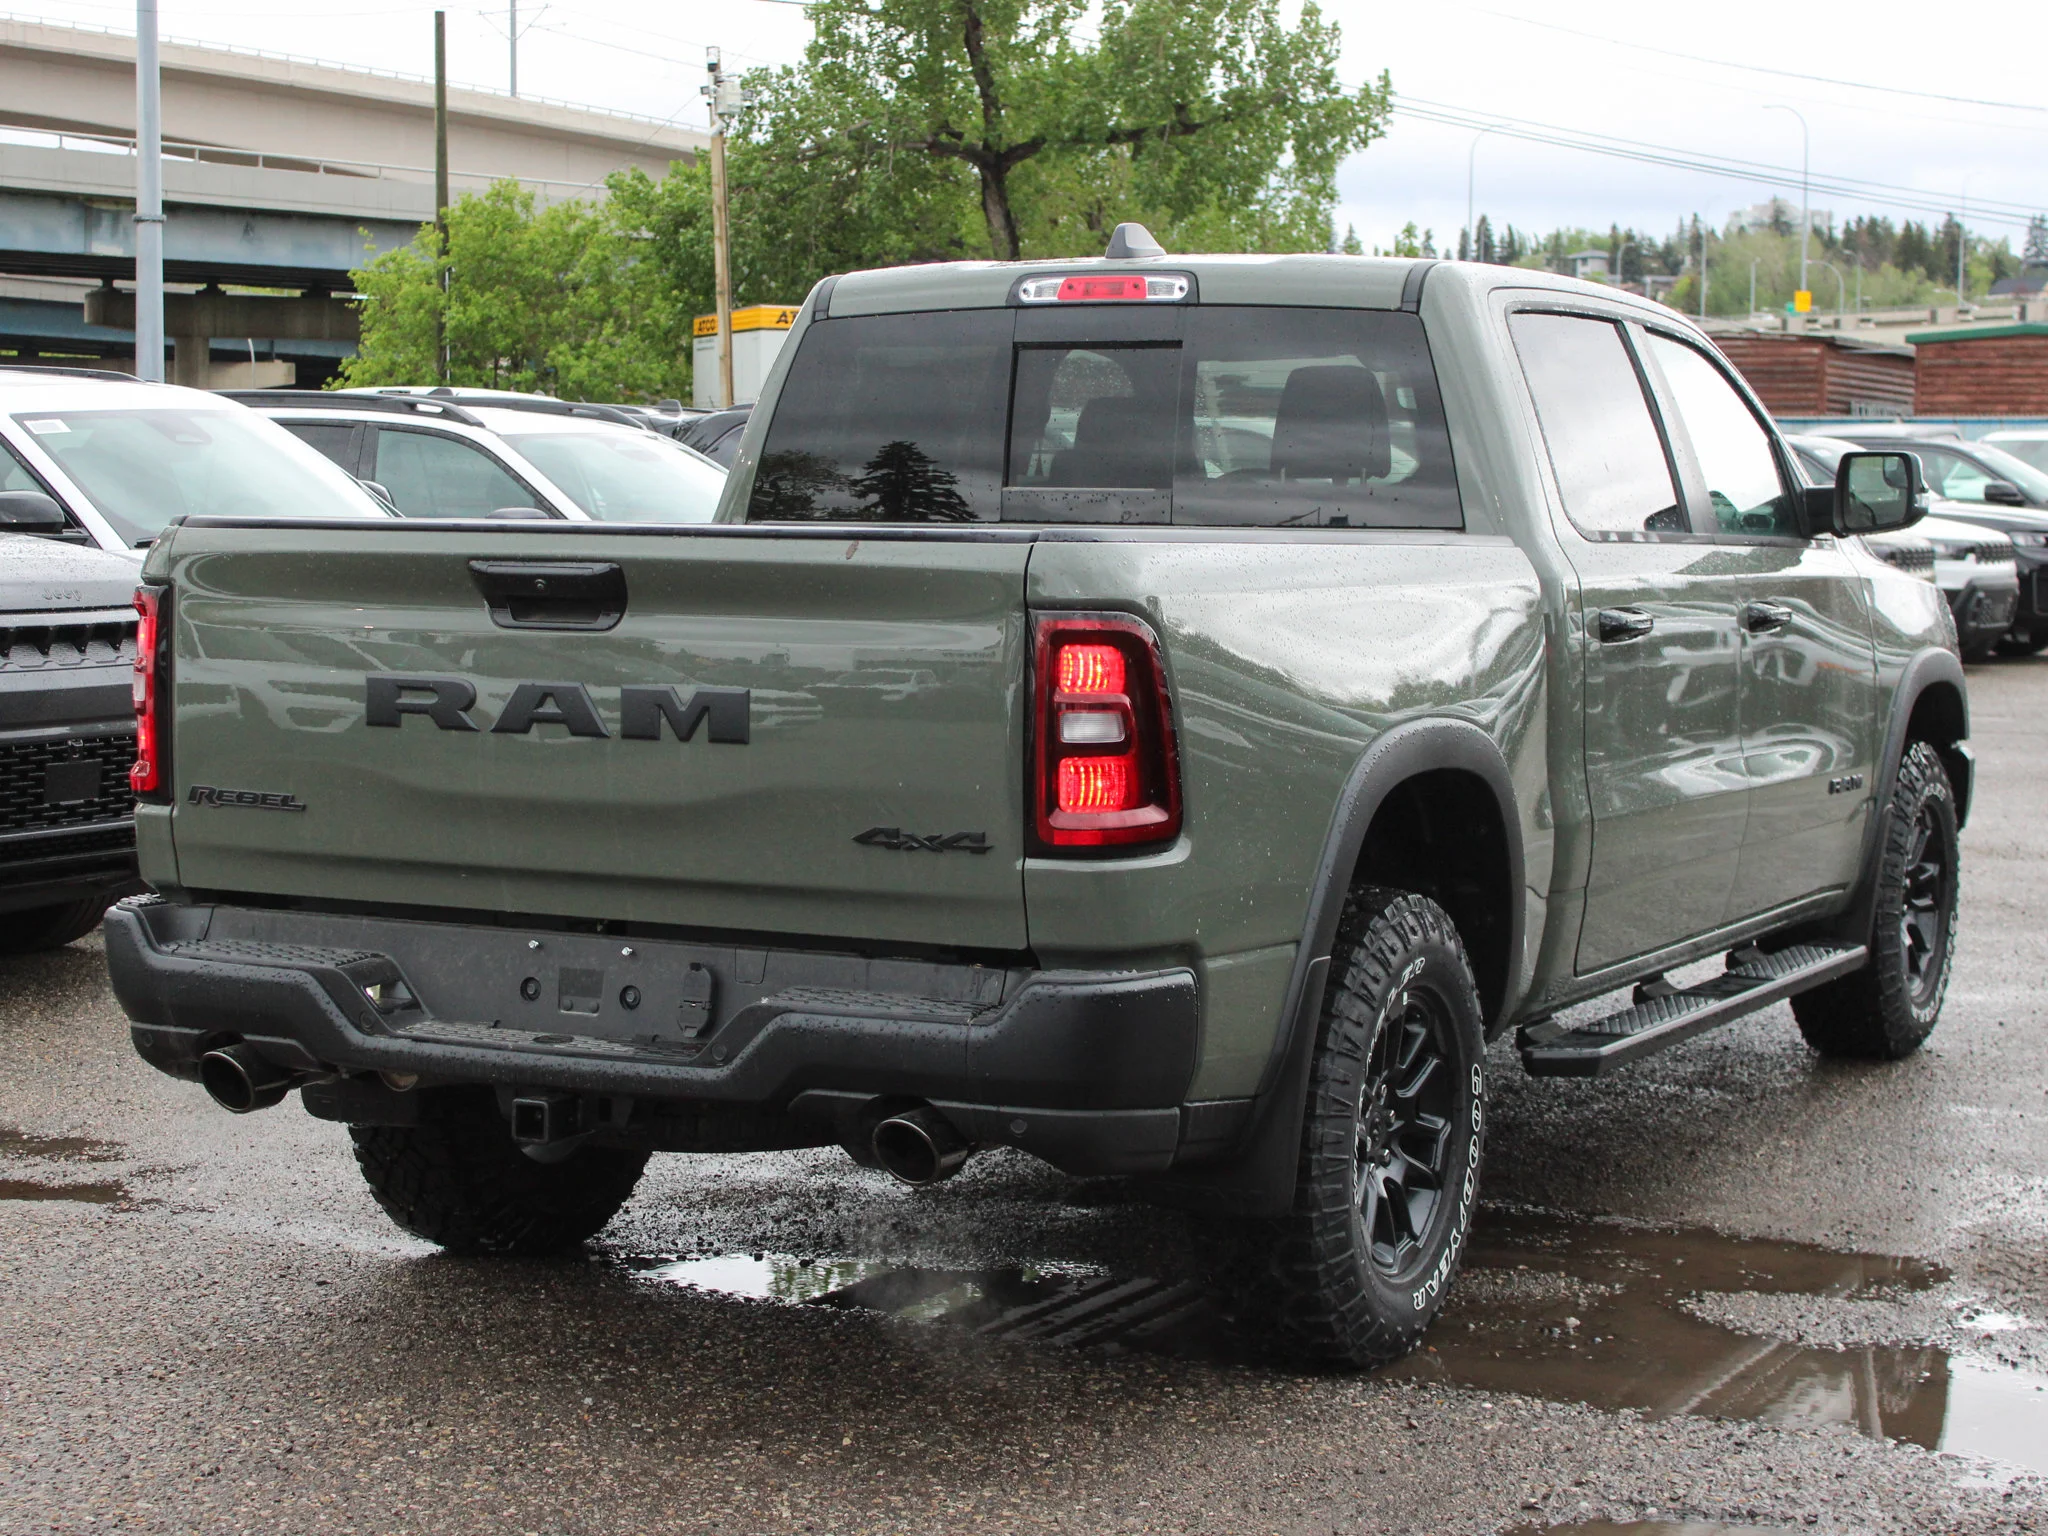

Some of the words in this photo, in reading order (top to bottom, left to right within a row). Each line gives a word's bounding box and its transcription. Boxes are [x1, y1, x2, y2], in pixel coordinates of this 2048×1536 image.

[776, 310, 799, 324] AT
[41, 587, 81, 602] Jeep
[366, 672, 750, 744] RAM
[1828, 773, 1863, 795] RAM
[1413, 1064, 1482, 1310] GOODYEAR
